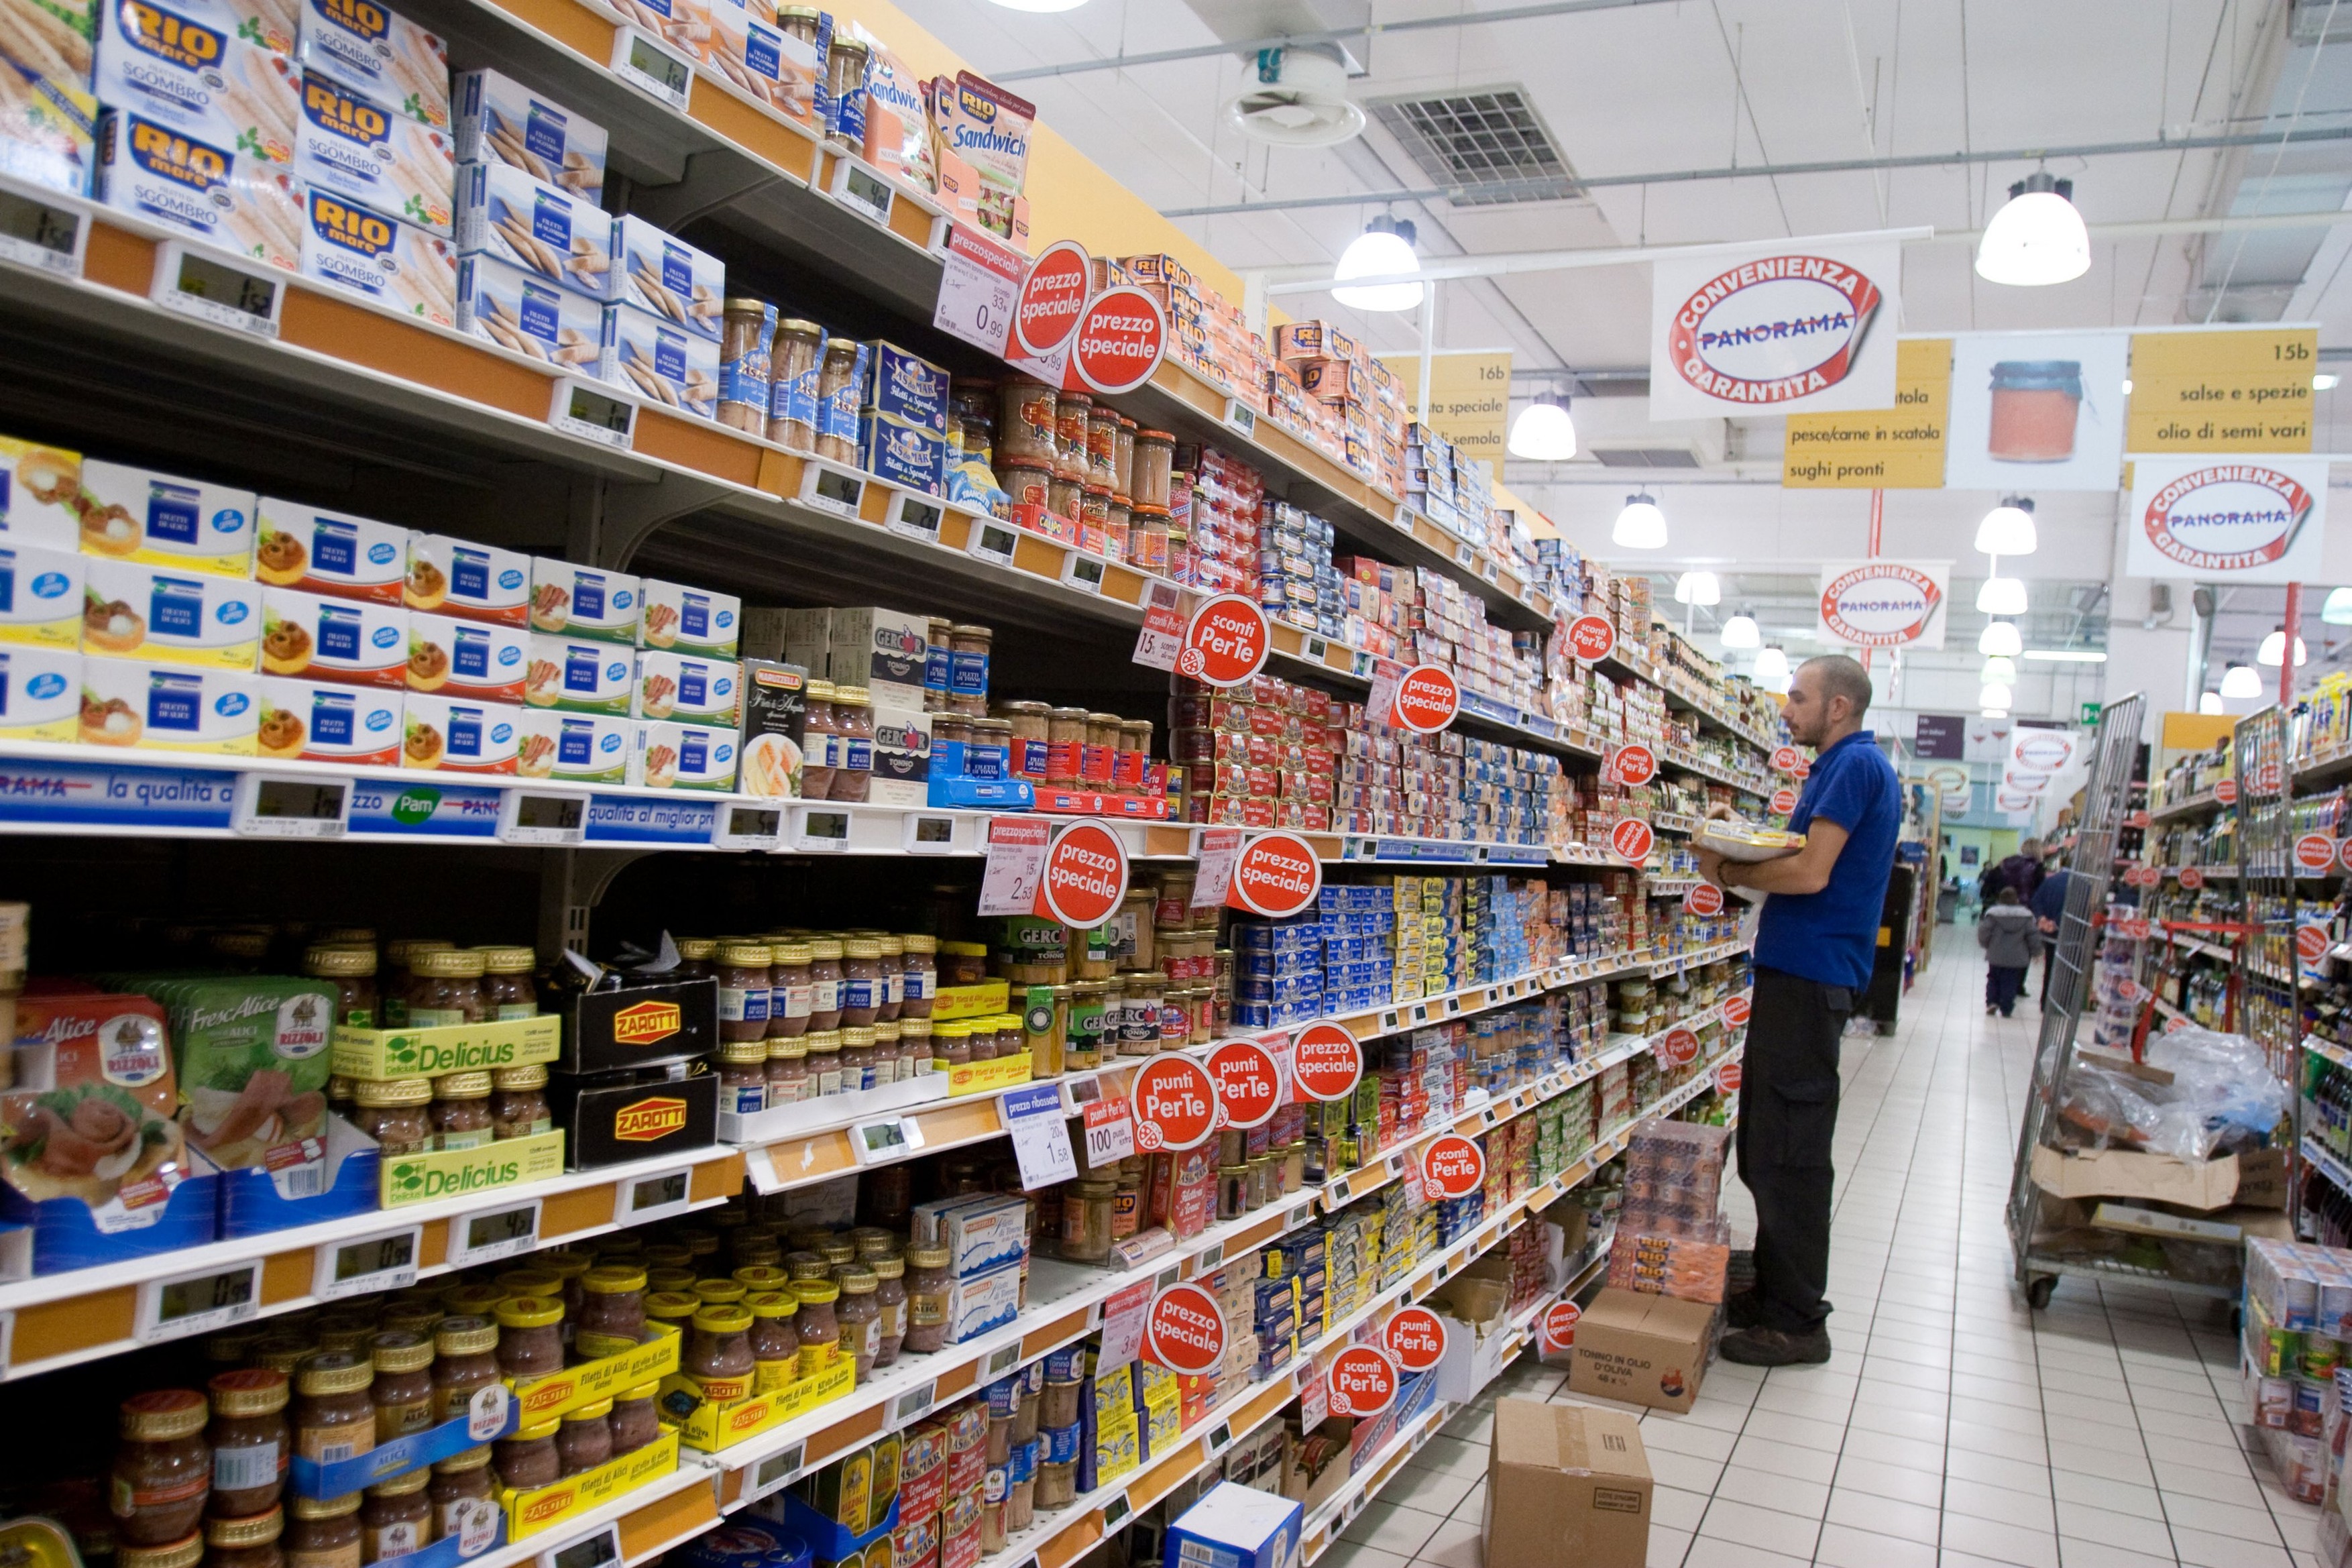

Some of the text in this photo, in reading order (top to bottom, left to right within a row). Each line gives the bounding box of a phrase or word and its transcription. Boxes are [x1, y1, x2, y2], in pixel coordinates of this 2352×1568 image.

[325, 7, 373, 38] mare
[137, 35, 199, 66] mare
[315, 29, 382, 71] SGOMBRO
[122, 62, 209, 105] SGOMBRO
[306, 84, 385, 136] RIO
[962, 91, 995, 116] RIO
[966, 105, 988, 121] mare
[321, 115, 371, 142] mare
[134, 122, 225, 180] RIO
[953, 123, 1026, 158] Sandwich
[309, 139, 381, 175] SGOMBRO
[148, 156, 208, 186] mare
[944, 174, 957, 188] RIO
[133, 184, 218, 225] SGOMBRO
[316, 197, 390, 247] RIO
[329, 229, 376, 254] mare
[952, 232, 1019, 276] prezzospeciale
[316, 253, 385, 287] SGOMBRO
[1165, 260, 1190, 288] RIO
[993, 286, 1011, 299] sconto
[1029, 271, 1082, 298] prezzo
[1679, 257, 1858, 330] CONVENIENZA
[1021, 290, 1082, 325] speciale
[1173, 287, 1202, 316] RIO
[976, 304, 1004, 339] 0,99
[1089, 313, 1155, 335] prezzo
[1178, 317, 1206, 343] RIO
[1701, 311, 1849, 350] PANORAMA
[1080, 333, 1156, 359] speciale
[1332, 334, 1353, 354] RIO
[2274, 344, 2309, 360] 15b
[1198, 359, 1226, 385] RIO
[1371, 363, 1391, 384] RIO
[1479, 366, 1505, 380] 16b
[1683, 357, 1827, 402] GARANTITA
[890, 385, 909, 400] Filetti
[916, 383, 934, 394] MAR
[1278, 378, 1299, 397] RIO
[2180, 384, 2307, 404] salse e spezie
[1449, 398, 1503, 416] speciale
[1290, 410, 1310, 431] RIO
[2158, 422, 2306, 440] olio di semi vari
[1453, 431, 1501, 445] semola
[1792, 424, 1940, 445] pesce/carne in scatola
[911, 452, 929, 463] MAR
[1790, 461, 1885, 480] sughi pronti
[2153, 466, 2295, 514] CONVENIENZA
[2171, 510, 2288, 528] PANORAMA
[2154, 530, 2270, 570] GARANTITA
[1200, 562, 1223, 579] PALMERA
[1829, 565, 1931, 600] CONVENIENZA
[1840, 600, 1923, 612] PANORAMA
[1149, 614, 1184, 632] sconti PerTe
[1211, 614, 1257, 638] sconti
[1581, 623, 1606, 636] sconti
[1828, 614, 1909, 645] GARANTITA
[1198, 626, 1253, 663] PerTe
[1575, 632, 1607, 650] PerTe
[887, 661, 910, 670] TONNO
[1408, 679, 1452, 697] prezzo
[1401, 693, 1452, 716] speciale
[889, 759, 913, 767] TONNO
[1619, 757, 1648, 775] PerTe
[1624, 752, 1648, 763] sconti
[107, 777, 213, 805] la qualità
[399, 794, 433, 813] Pam
[588, 804, 695, 829] qualità al miglior
[993, 824, 1046, 841] prezzospeciale
[1618, 822, 1636, 852] prezzo
[1625, 826, 1646, 857] speciale
[1060, 843, 1117, 873] prezzo
[1251, 848, 1310, 875] prezzo
[1011, 877, 1033, 901] 2,53
[1050, 866, 1117, 899] speciale
[1242, 866, 1310, 895] speciale
[1692, 896, 1720, 907] speciale
[1695, 889, 1718, 899] prezzo
[190, 997, 282, 1033] FrescAlice
[616, 1011, 680, 1035] ZAROTTI
[278, 1031, 323, 1046] RIZZOLI
[1301, 1040, 1350, 1058] prezzo
[107, 1058, 160, 1073] RIZZOLI
[418, 1040, 515, 1072] Delicius
[1219, 1056, 1258, 1079] punti
[1298, 1056, 1356, 1076] speciale
[1152, 1070, 1193, 1093] punti
[1216, 1076, 1270, 1099] PerTe
[1009, 1095, 1059, 1116] prezzo ribassato
[1090, 1101, 1125, 1126] punti PerTe
[1146, 1093, 1206, 1118] PerTe
[618, 1108, 686, 1131] ZAROTTI
[1047, 1141, 1069, 1164] 1,58
[1090, 1128, 1111, 1155] 100
[1435, 1147, 1469, 1160] sconti
[424, 1160, 519, 1197] Delicius
[1432, 1160, 1475, 1178] PerTe
[1006, 1225, 1023, 1236] Tonno
[1641, 1237, 1669, 1247] RIO
[1638, 1251, 1665, 1261] RIO
[1637, 1266, 1664, 1276] RIO
[1000, 1287, 1018, 1298] Tonno
[915, 1304, 938, 1313] ALICI
[1162, 1300, 1217, 1332] prezzo
[1154, 1319, 1219, 1353] speciale
[1400, 1320, 1431, 1339] punti
[1393, 1333, 1437, 1351] PerTe
[1049, 1361, 1070, 1370] Tonno
[1343, 1359, 1382, 1375] sconti
[1579, 1348, 1651, 1369] TONNO IN OLIO
[1594, 1361, 1632, 1378] D'OLIVA
[580, 1359, 629, 1386] Filetti Alici
[1049, 1367, 1068, 1375] Rosa
[775, 1383, 813, 1405] Filetti Alici
[1340, 1374, 1388, 1394] PerTe
[524, 1384, 571, 1412] ZAROTTI
[989, 1391, 1009, 1402] Tonno
[989, 1400, 1008, 1408] Rosa
[473, 1414, 504, 1431] RIZZOLI
[732, 1407, 768, 1429] ZAROTTI
[970, 1422, 985, 1442] MAR
[901, 1451, 941, 1481] AS MAR
[581, 1464, 629, 1494] Filetti Alici
[524, 1494, 573, 1523] ZAROTTI
[463, 1528, 494, 1548] RIZZOLI
[897, 1537, 934, 1567] AS MAR
